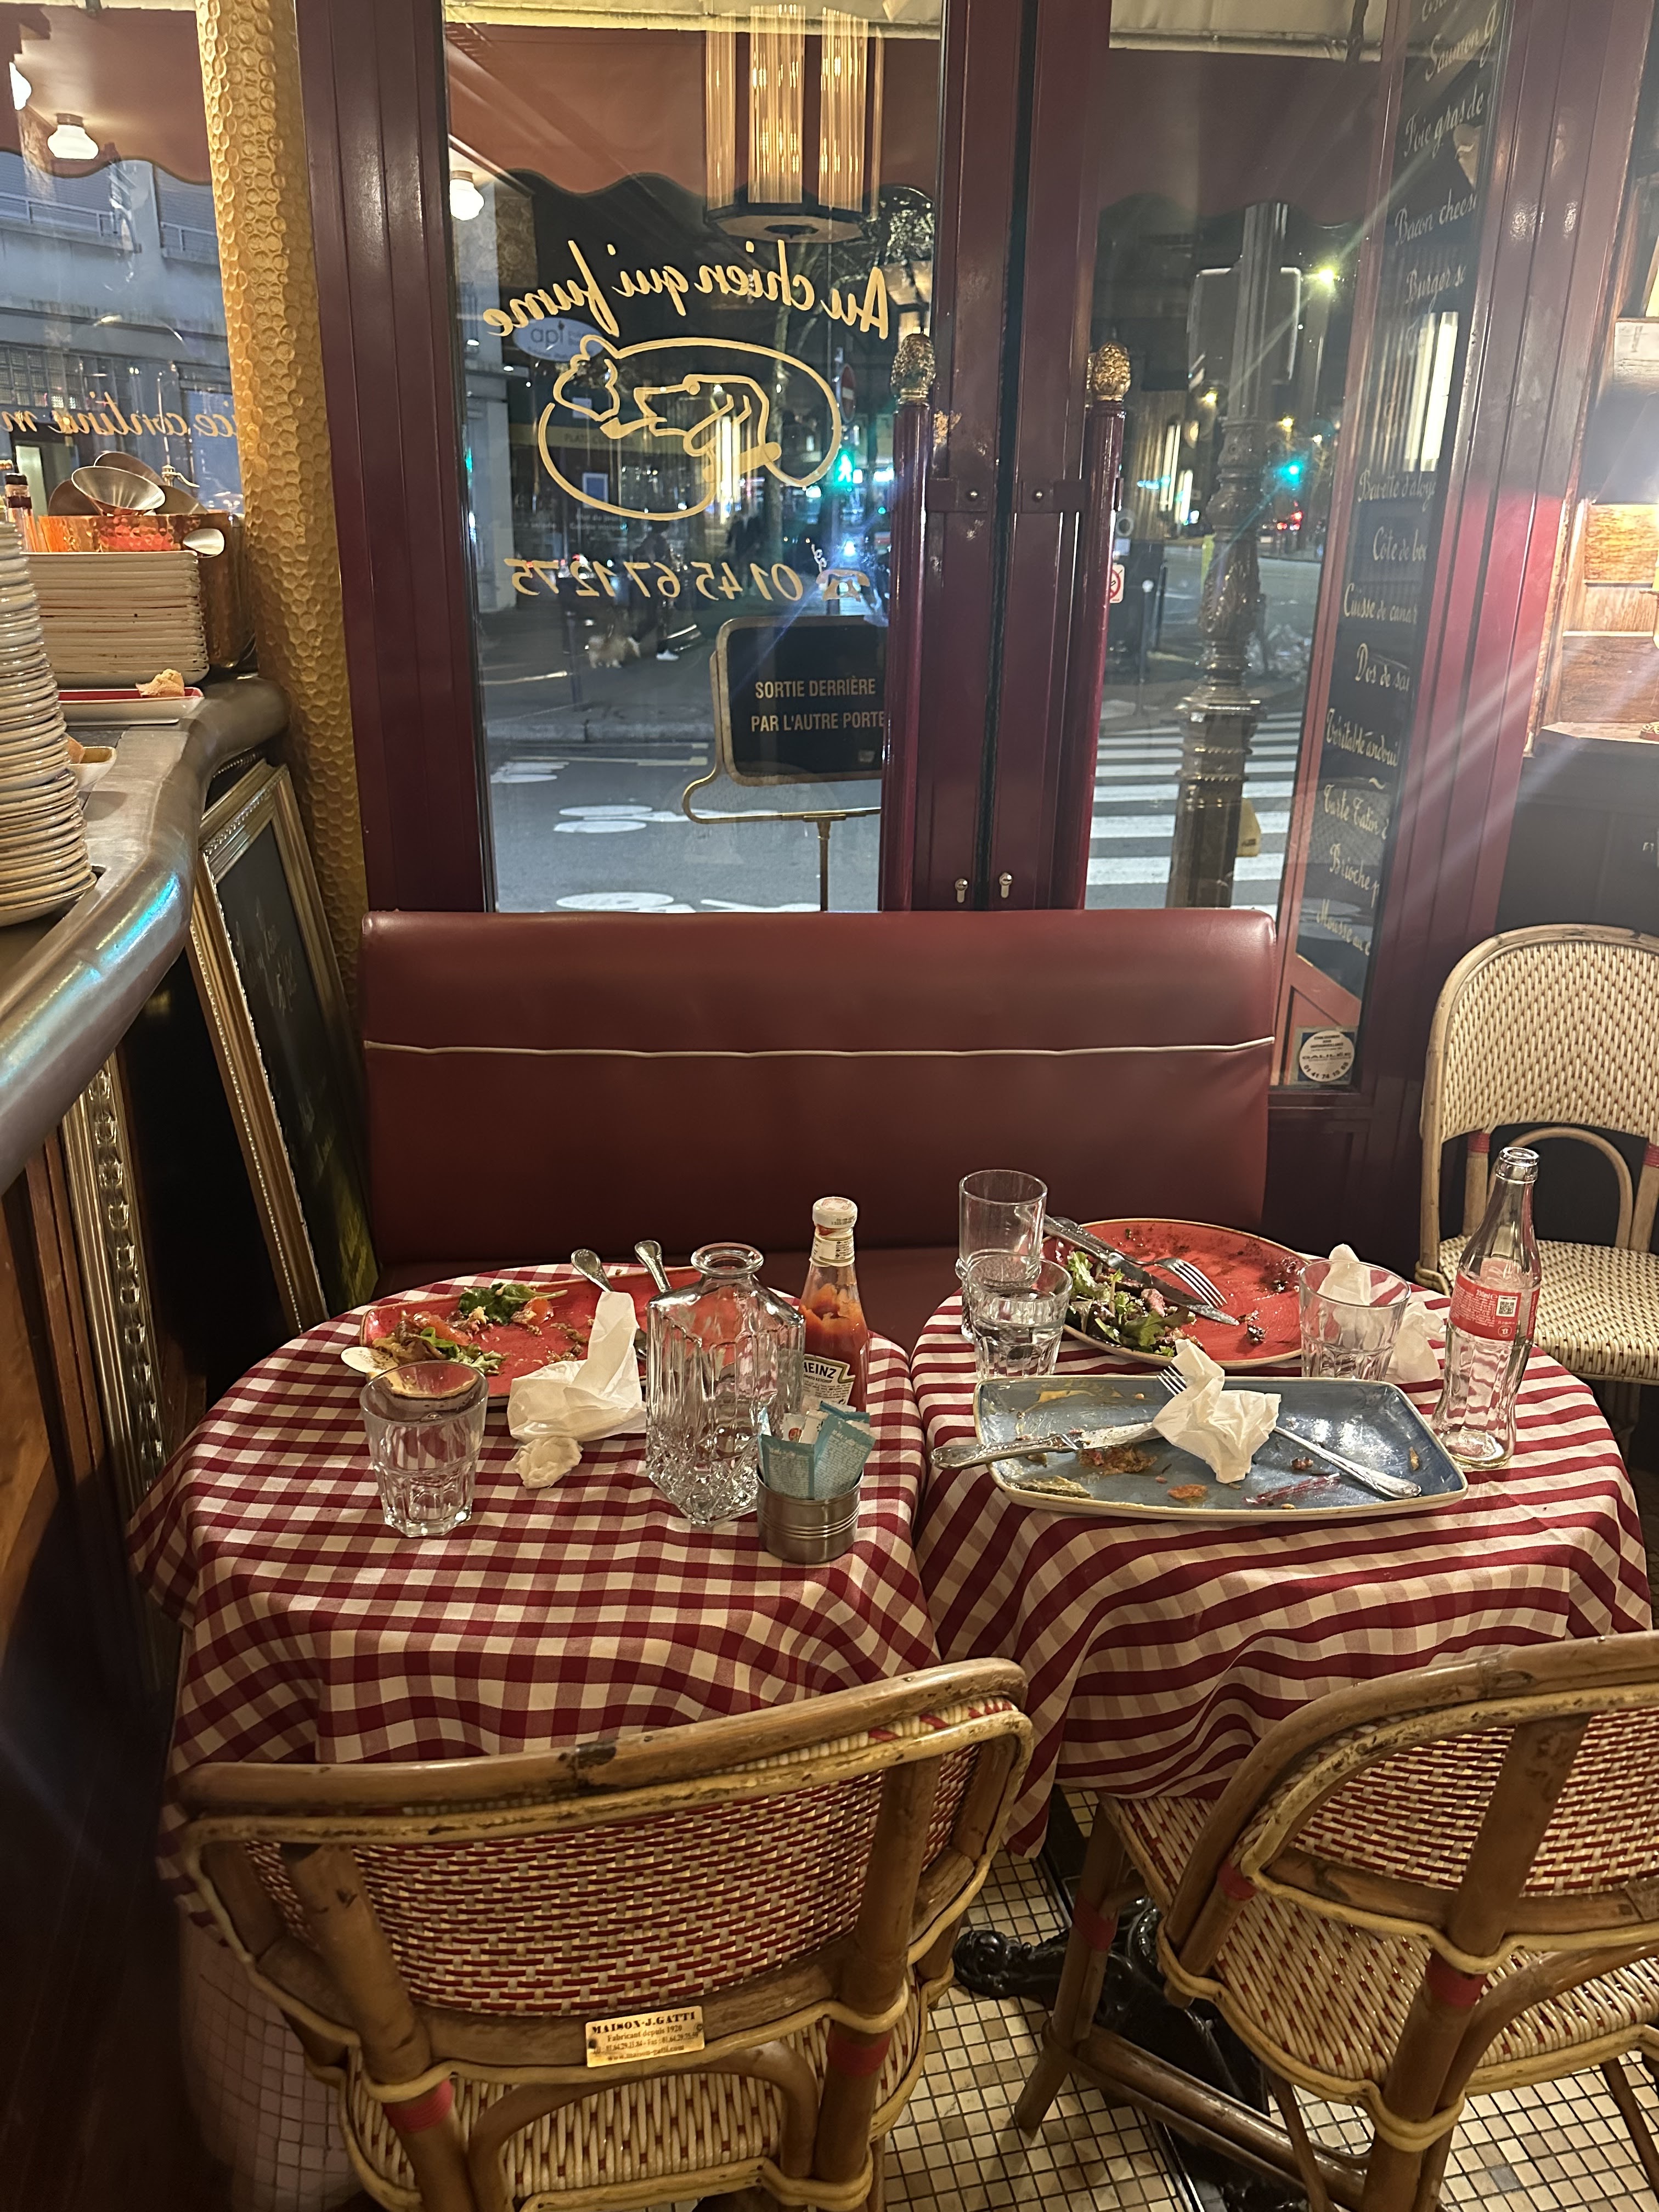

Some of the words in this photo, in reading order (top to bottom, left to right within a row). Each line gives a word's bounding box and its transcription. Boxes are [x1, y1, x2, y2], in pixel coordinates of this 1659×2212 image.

[1466, 83, 1484, 121] de
[1395, 204, 1434, 247] Bacon
[1344, 583, 1375, 618] Cuisse
[1376, 599, 1387, 621] de
[1355, 643, 1377, 684] Dos
[1379, 664, 1391, 687] de
[755, 681, 805, 699] SORTIE
[809, 675, 877, 697] DERRIÈRE
[751, 714, 780, 732] PAR
[783, 713, 839, 732] L'AUTRE
[843, 710, 885, 729] PORTE
[1324, 784, 1350, 821] Tarte
[1330, 843, 1370, 891] Brioche
[607, 2031, 641, 2042] Fabricant
[642, 2027, 665, 2037] depuis
[667, 2024, 682, 2033] 1920
